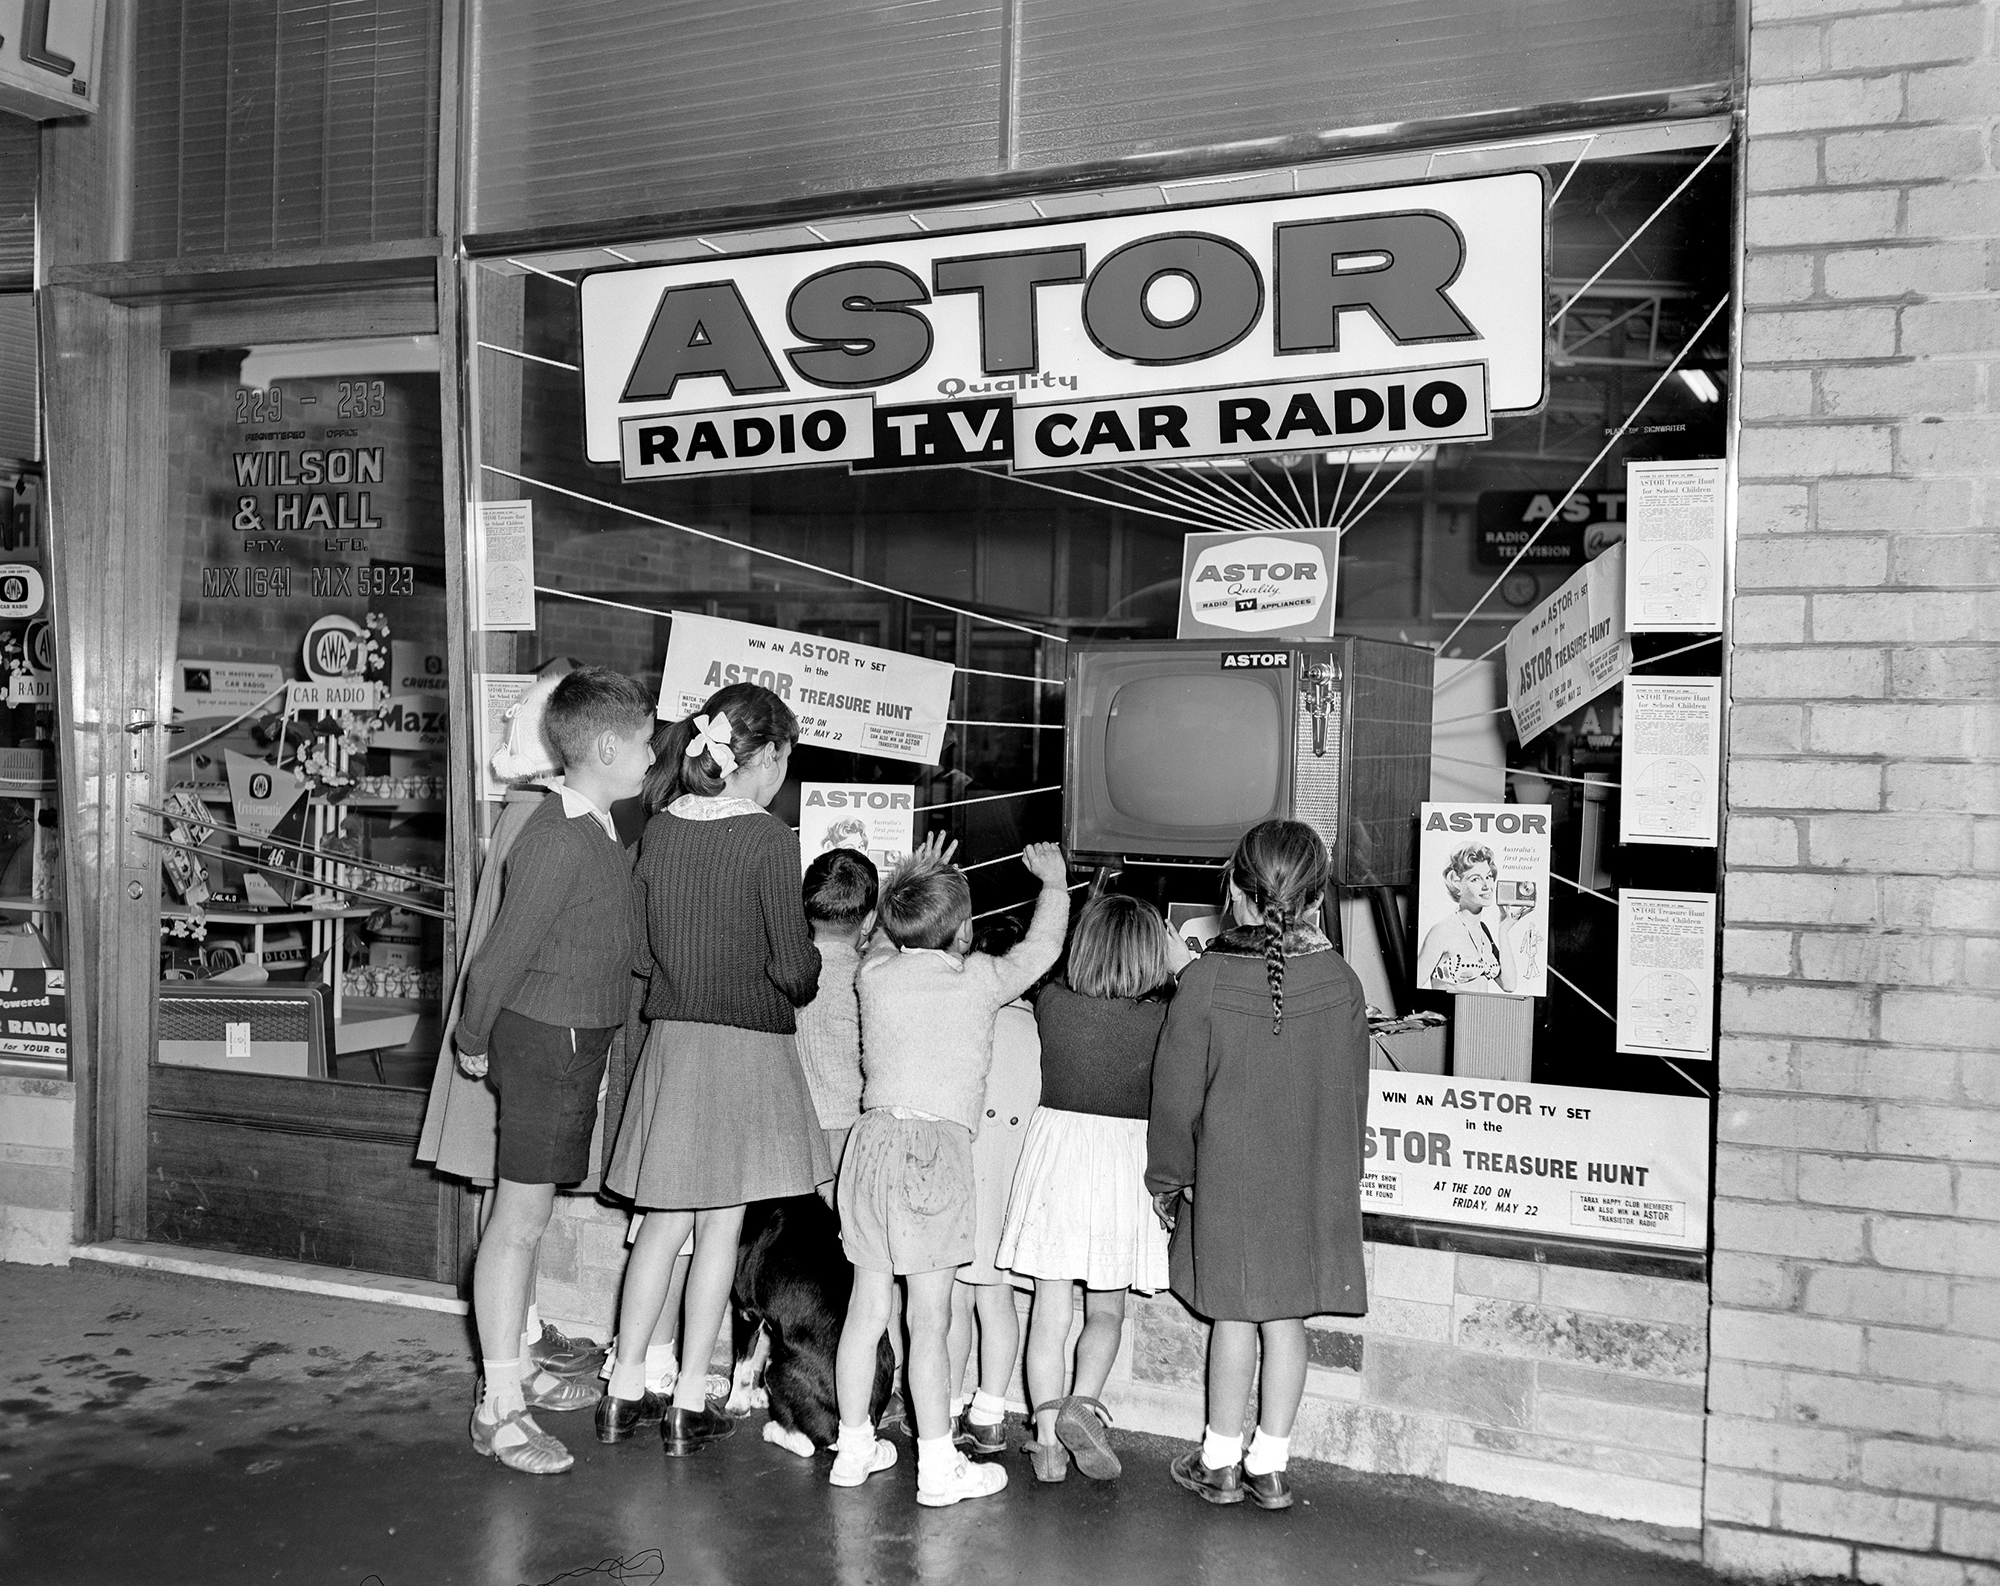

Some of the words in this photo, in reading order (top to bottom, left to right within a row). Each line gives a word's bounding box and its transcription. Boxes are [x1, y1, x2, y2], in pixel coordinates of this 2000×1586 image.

[619, 208, 1485, 402] ASTOR
[937, 371, 1078, 399] Quality
[235, 387, 283, 424] 229
[337, 380, 385, 419] 233
[638, 408, 847, 466] RADIO
[886, 408, 1004, 458] T.V.
[1034, 404, 1191, 458] CAR
[1219, 381, 1467, 444] RADIO
[233, 447, 384, 486] WILSON
[232, 494, 265, 531] &
[275, 492, 382, 530] HALL
[1522, 492, 1626, 523] AST
[245, 539, 284, 552] PTY.
[325, 538, 368, 551] LTD.
[1485, 531, 1529, 543] RADIO
[1497, 545, 1571, 558] TELVISION
[1196, 563, 1318, 582] ASTOR
[202, 567, 240, 597] MX
[245, 566, 291, 597] 1641
[311, 566, 352, 597] MX
[357, 566, 414, 597] 5923
[1227, 582, 1281, 598] Quality
[1238, 601, 1254, 610] TV
[1261, 599, 1311, 610] APPLIANCES
[1547, 590, 1573, 625] ASTOR
[321, 634, 347, 670] AWA
[748, 638, 766, 650] WIN
[771, 642, 784, 653] AN
[789, 641, 850, 665] ASTOR
[855, 658, 865, 668] TV
[870, 662, 887, 672] SET
[1519, 645, 1553, 696] ASTOR
[1555, 631, 1587, 671] TREASURE
[1588, 617, 1611, 646] HUNT
[1224, 654, 1288, 667] ASTOR
[804, 664, 811, 673] in
[816, 666, 829, 677] the
[18, 682, 50, 696] RADI
[243, 681, 265, 689] RADIO
[704, 660, 794, 700] ASTOR
[799, 687, 871, 714] TREASURE
[876, 702, 913, 721] HUNT
[293, 687, 318, 703] CAR
[326, 687, 365, 703] RADIO
[800, 715, 815, 725] ZOO
[817, 717, 827, 727] ON
[814, 729, 830, 739] MAY
[833, 732, 843, 741] 22
[904, 738, 920, 746] ASTOR
[805, 790, 912, 810] ASTOR
[1425, 812, 1547, 834] ASTOR
[267, 848, 285, 867] 46
[1672, 917, 1702, 925] Children
[4, 1043, 17, 1051] for
[23, 1044, 50, 1053] YOUR
[1382, 1091, 1407, 1103] WIN
[1416, 1095, 1433, 1106] AN
[1441, 1088, 1532, 1115] ASTOR
[1539, 1105, 1556, 1116] TV
[1566, 1107, 1591, 1120] SET
[1465, 1119, 1476, 1130] in
[1483, 1121, 1503, 1133] the
[1363, 1126, 1451, 1167] STOR
[1462, 1150, 1578, 1180] TREASURE
[1587, 1162, 1649, 1187] HUNT
[1364, 1173, 1378, 1181] APPY
[1381, 1174, 1397, 1182] SHOW
[1375, 1191, 1393, 1199] FOUND
[1378, 1183, 1396, 1191] WHERE
[1433, 1181, 1447, 1192] AT
[1451, 1182, 1468, 1194] THE
[1473, 1185, 1492, 1196] ZOO
[1497, 1188, 1512, 1198] ON
[1452, 1197, 1488, 1212] FRIDAY,
[1495, 1202, 1519, 1213] MAY
[1525, 1205, 1538, 1216] 22
[1580, 1196, 1599, 1204] TARAX
[1602, 1198, 1621, 1206] HAPPY
[1625, 1200, 1640, 1208] CLUB
[1643, 1202, 1673, 1212] MEMBERS
[1598, 1206, 1614, 1214] ALSO
[1643, 1210, 1670, 1221] ASTOR
[1598, 1214, 1634, 1225] TRANSISTOR
[1639, 1219, 1657, 1228] RADIO
